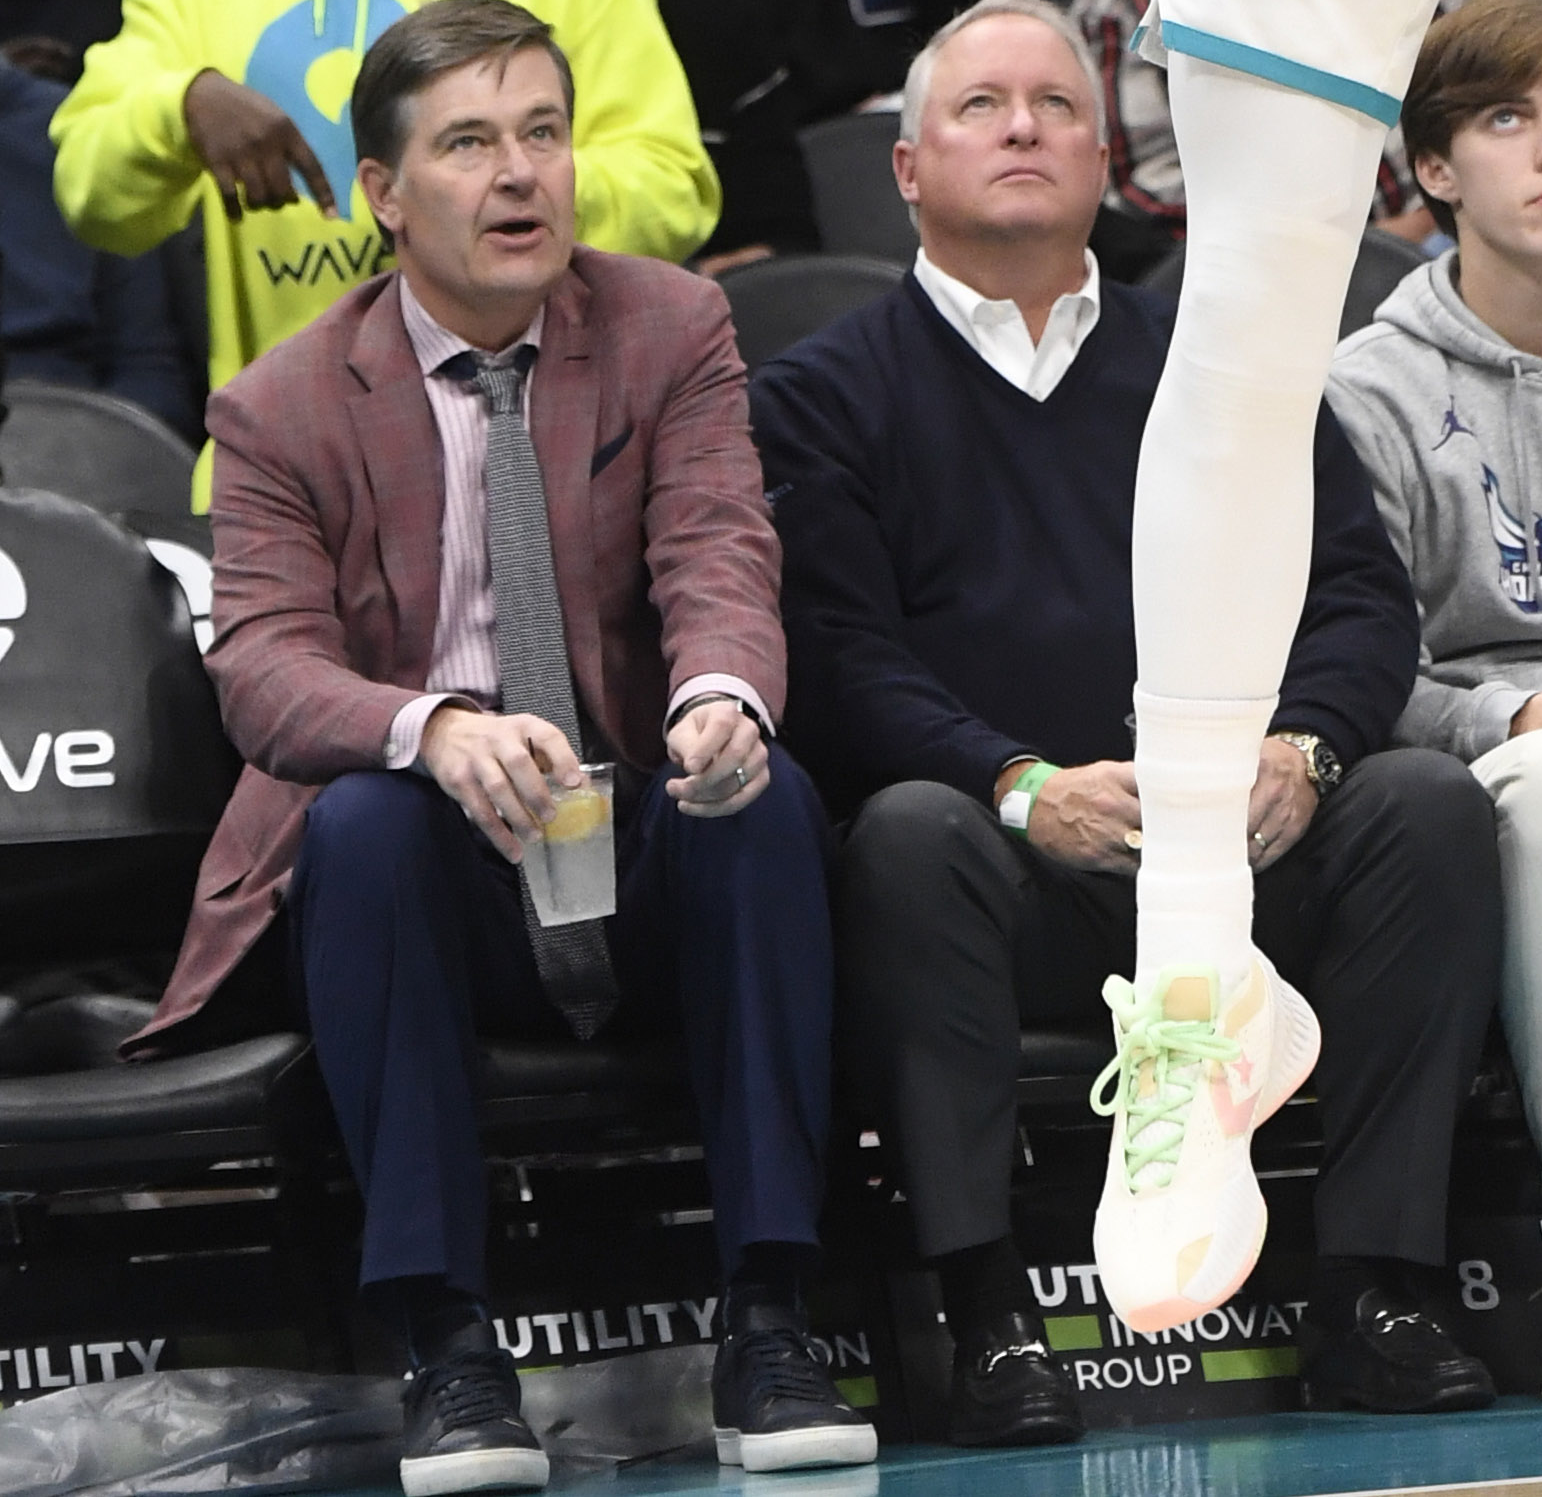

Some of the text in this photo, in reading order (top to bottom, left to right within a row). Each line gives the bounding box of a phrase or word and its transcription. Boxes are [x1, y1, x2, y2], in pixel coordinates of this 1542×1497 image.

[1458, 1259, 1501, 1311] 8
[492, 1297, 719, 1359] UTILITY
[1063, 1353, 1192, 1391] ROUP
